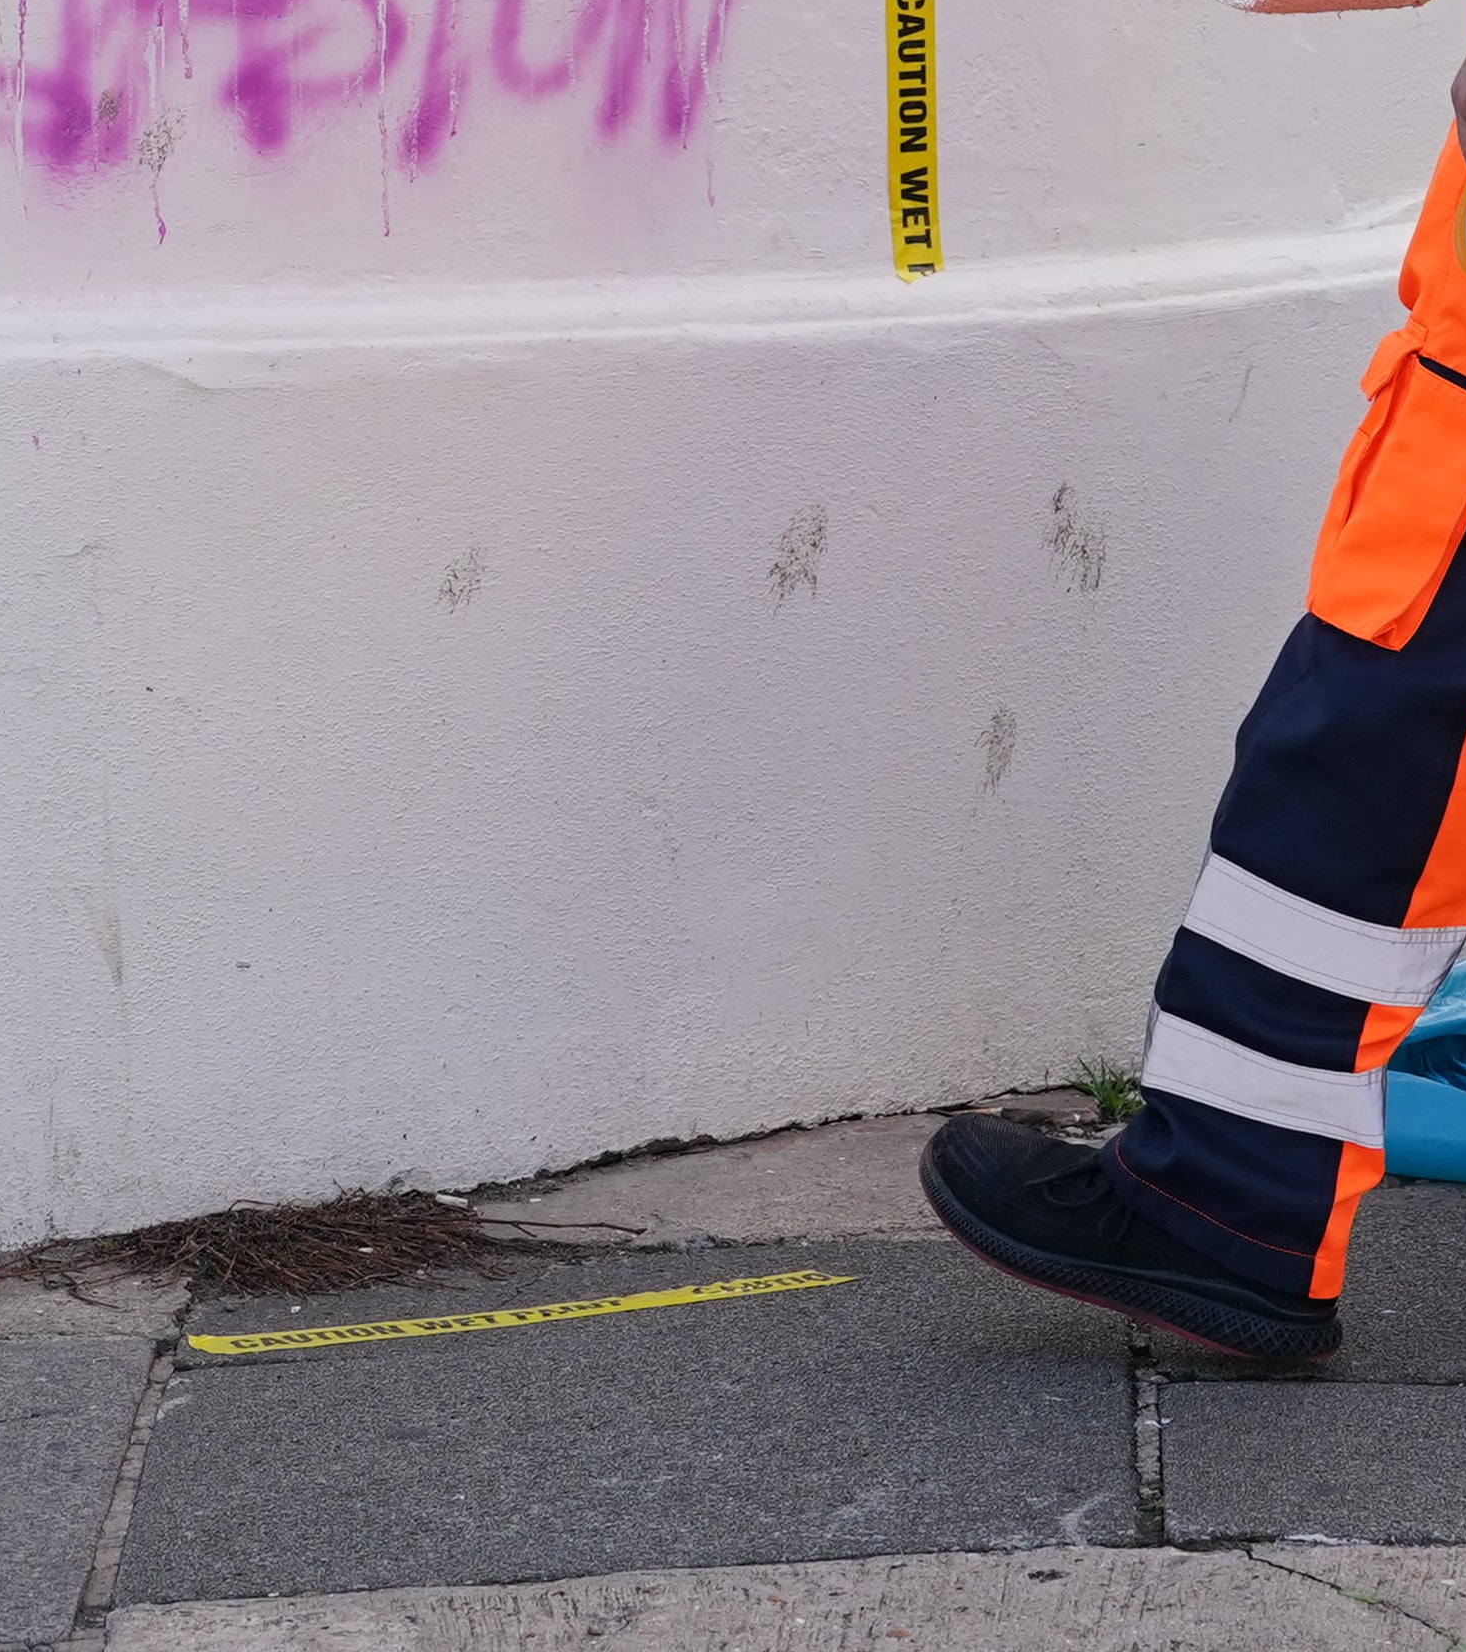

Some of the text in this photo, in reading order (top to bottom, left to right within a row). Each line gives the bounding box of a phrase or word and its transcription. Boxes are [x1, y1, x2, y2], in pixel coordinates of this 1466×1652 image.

[899, 166, 933, 250] WET
[229, 1324, 408, 1350] CAUTION
[412, 1314, 499, 1331] WET
